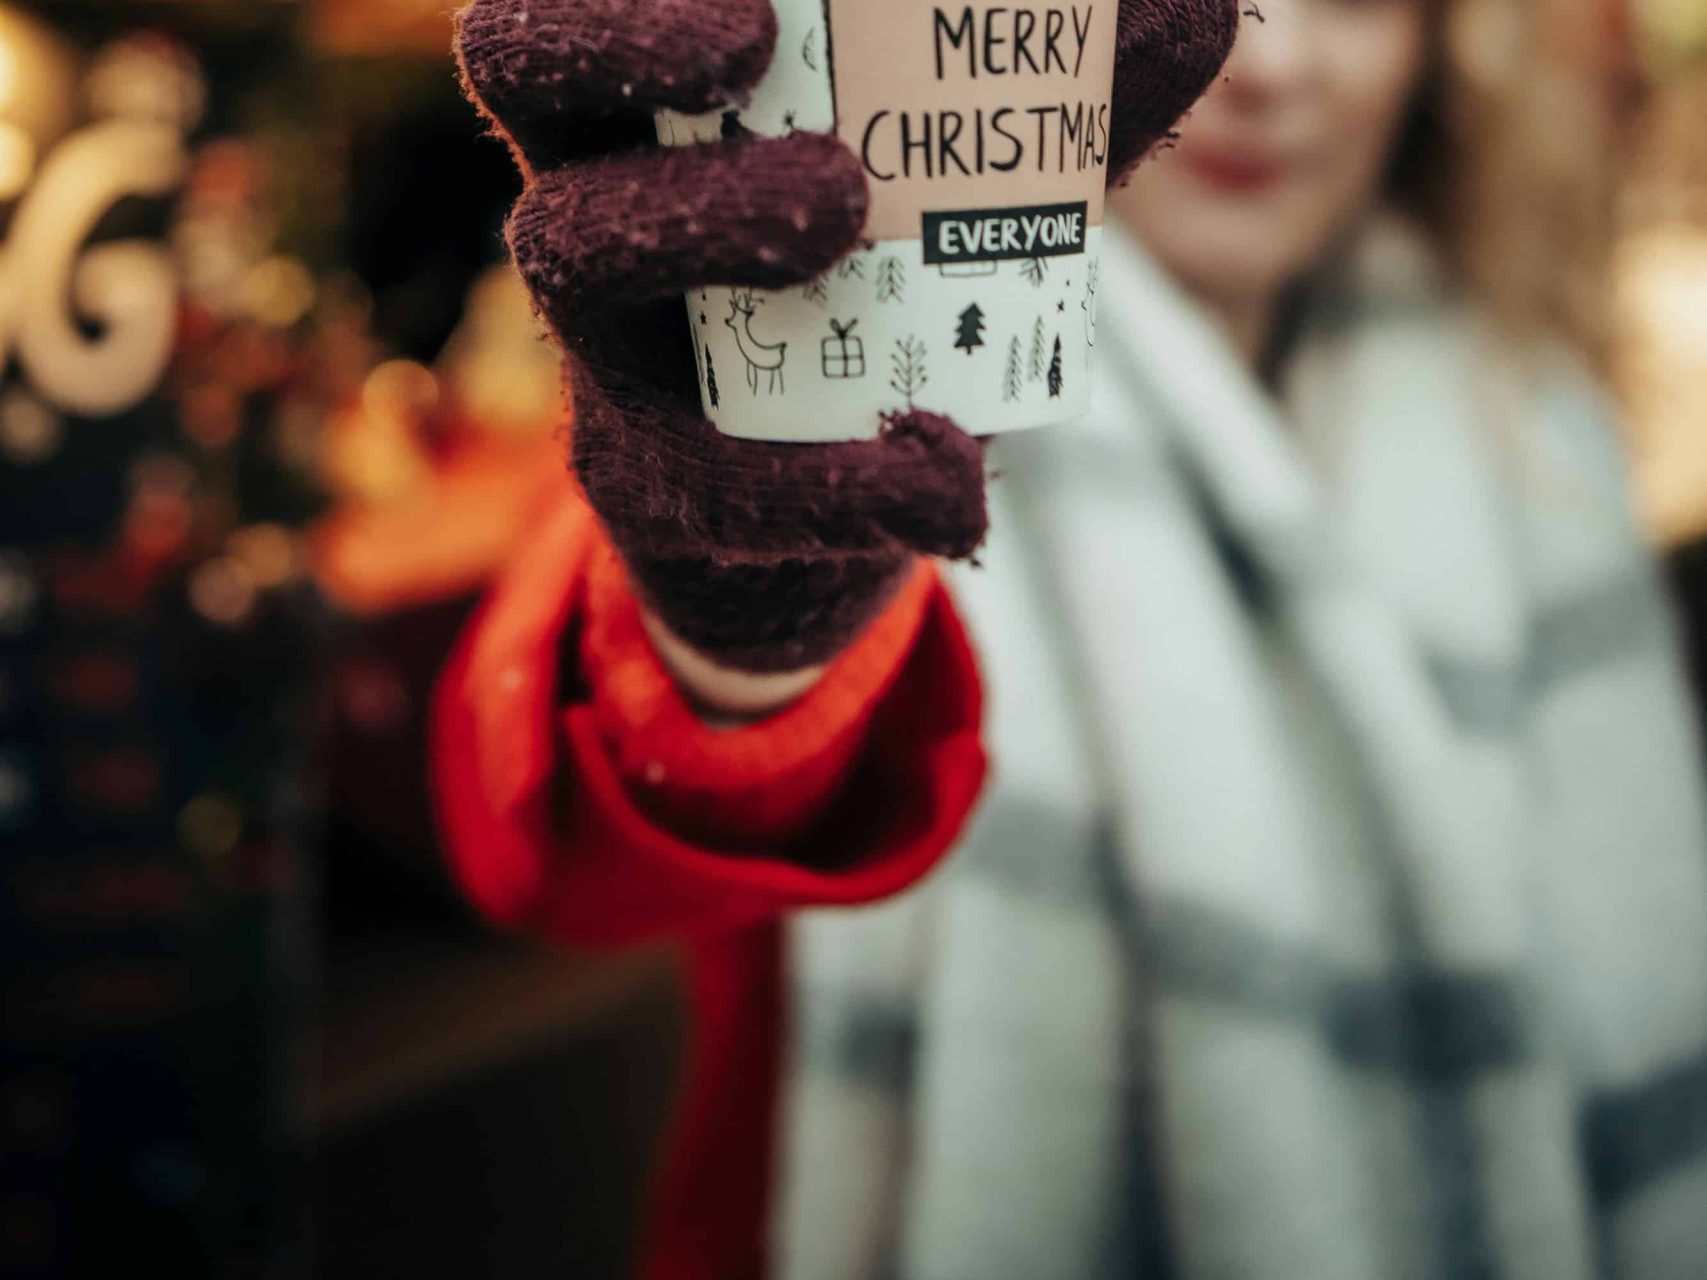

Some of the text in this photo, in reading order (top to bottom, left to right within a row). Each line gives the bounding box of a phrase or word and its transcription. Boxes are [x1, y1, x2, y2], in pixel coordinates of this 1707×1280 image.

[933, 5, 1093, 80] MERRY
[861, 101, 1107, 181] CHRISTMAS
[938, 212, 1082, 255] EVERYONE
